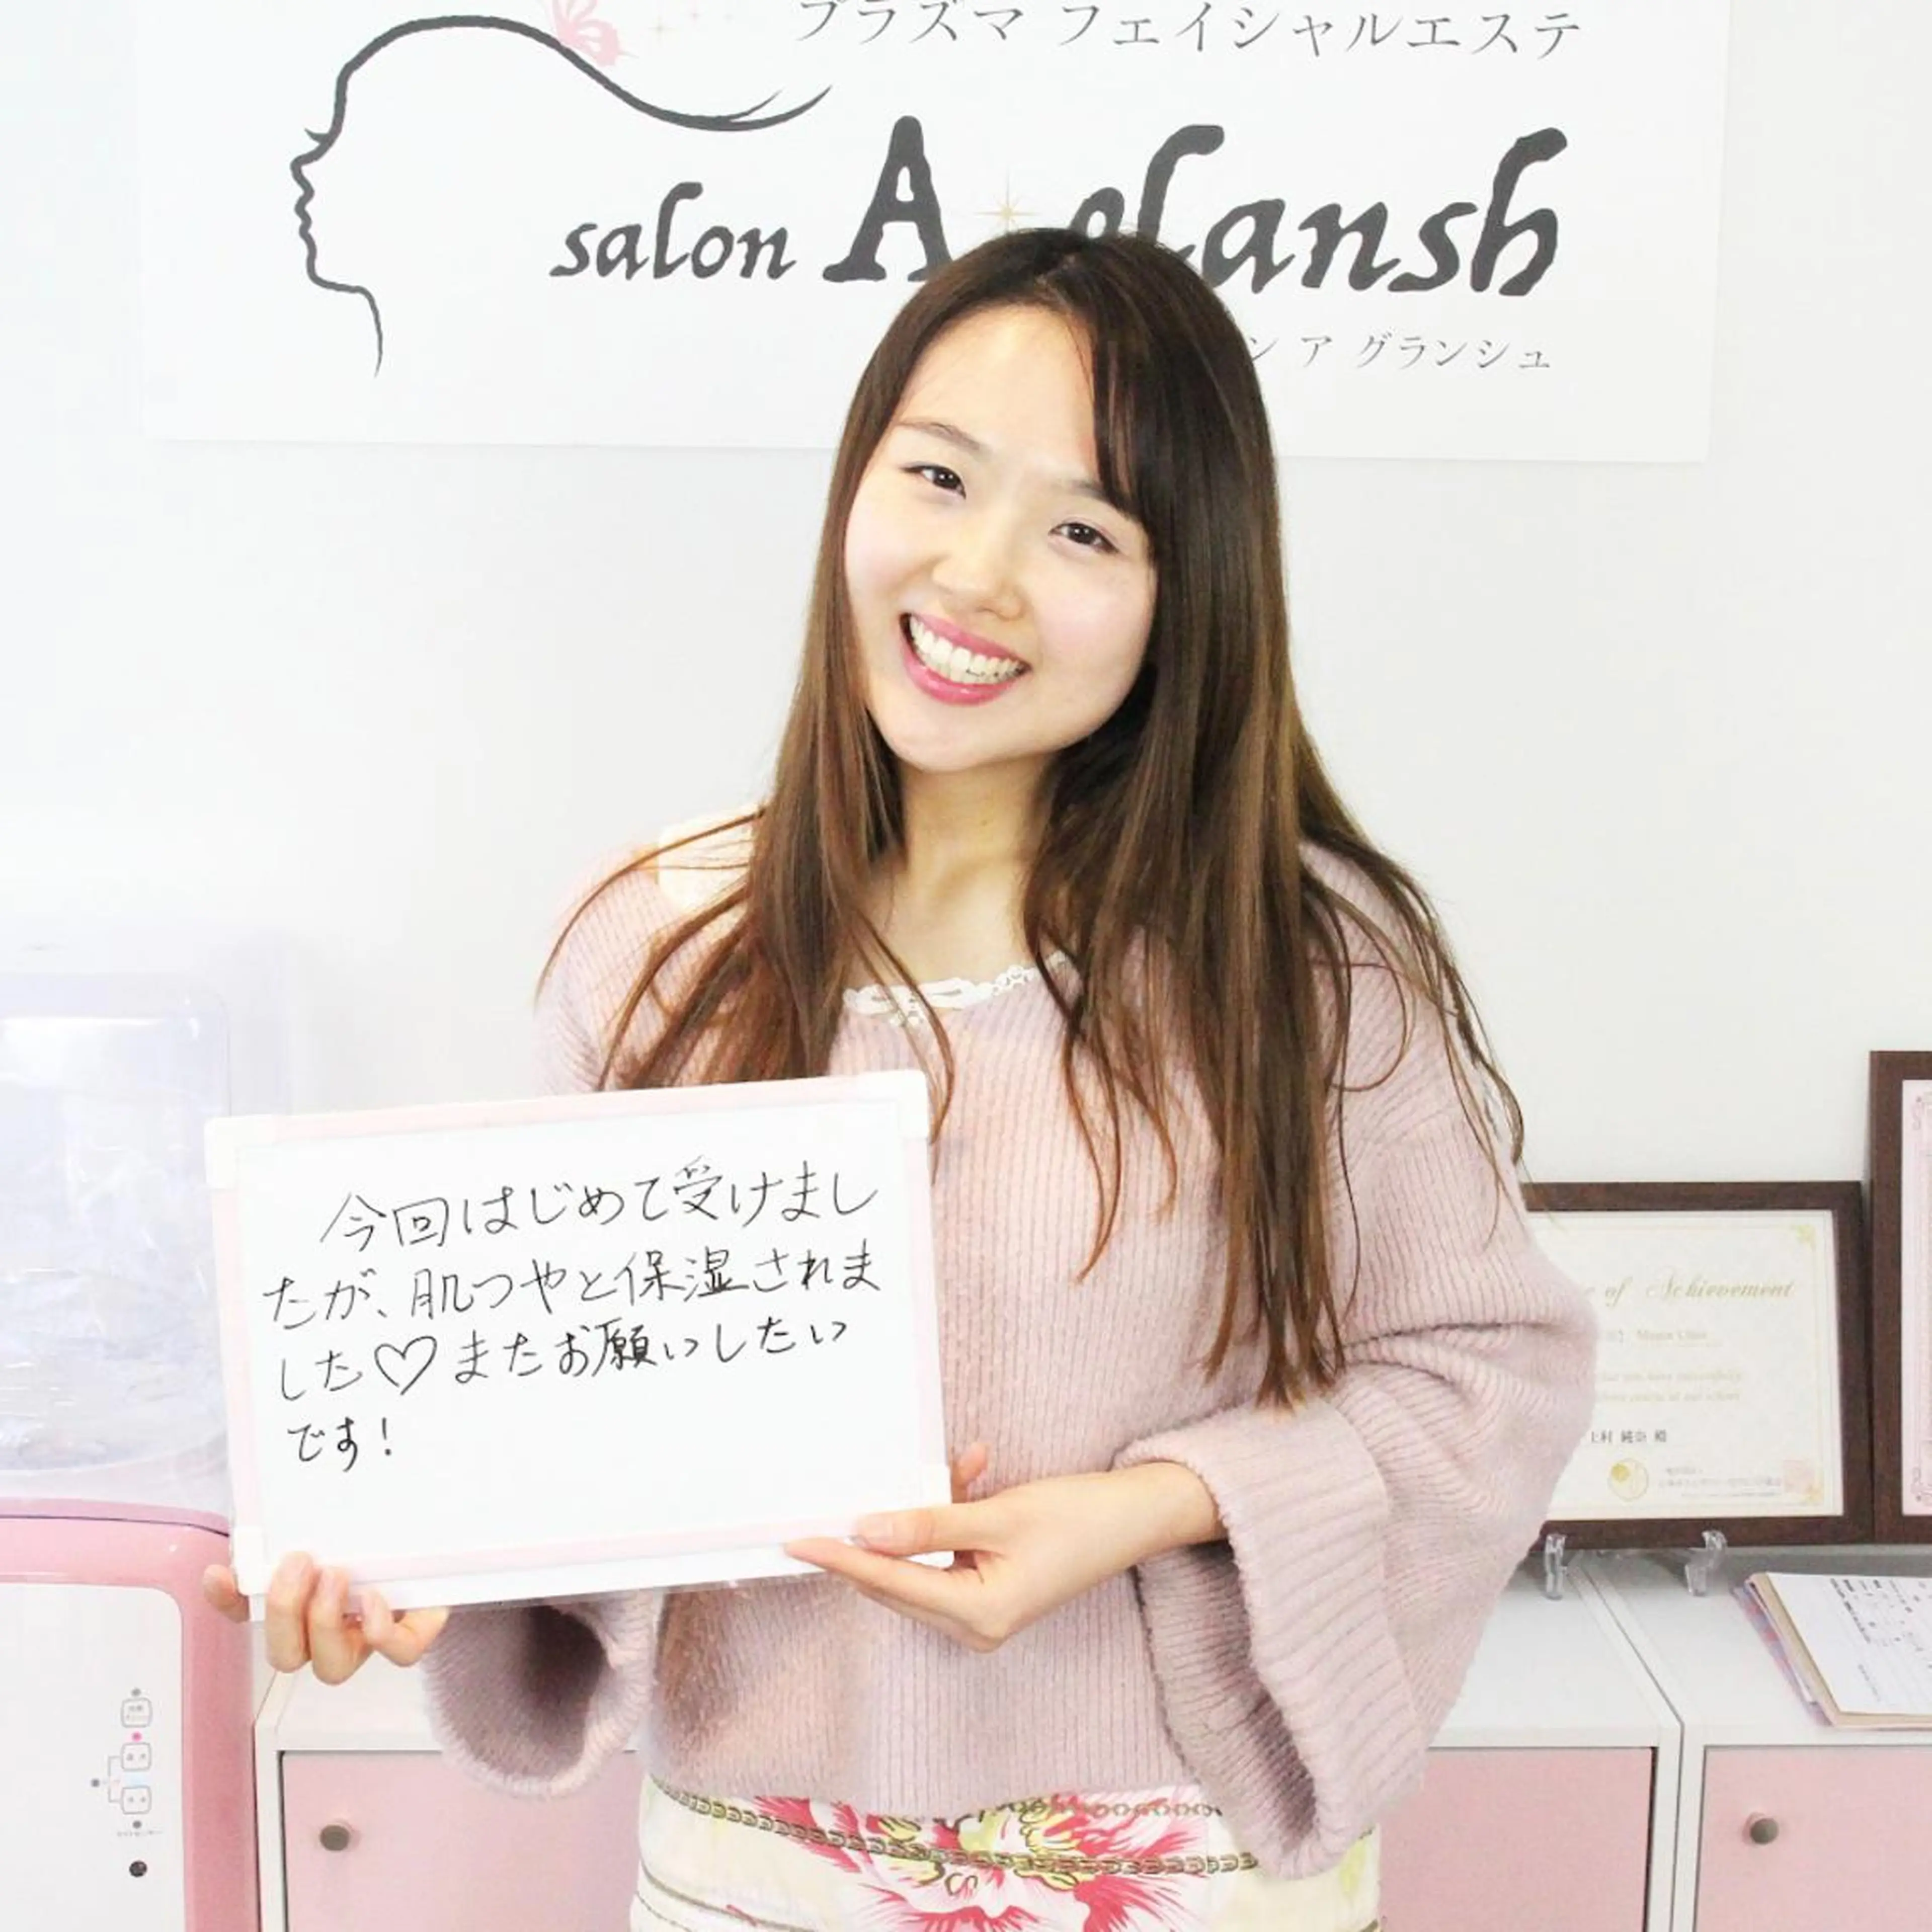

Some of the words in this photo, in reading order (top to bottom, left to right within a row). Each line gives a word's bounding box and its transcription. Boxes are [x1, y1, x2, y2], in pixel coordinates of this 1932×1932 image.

[1061, 3, 1580, 58] フェイシャルエステ
[549, 182, 796, 280] salon
[1300, 336, 1333, 367] ア
[1357, 330, 1551, 370] グランシュ
[320, 1155, 877, 1252] 今回はじめて受けまし
[1646, 1266, 1796, 1299] Achievement
